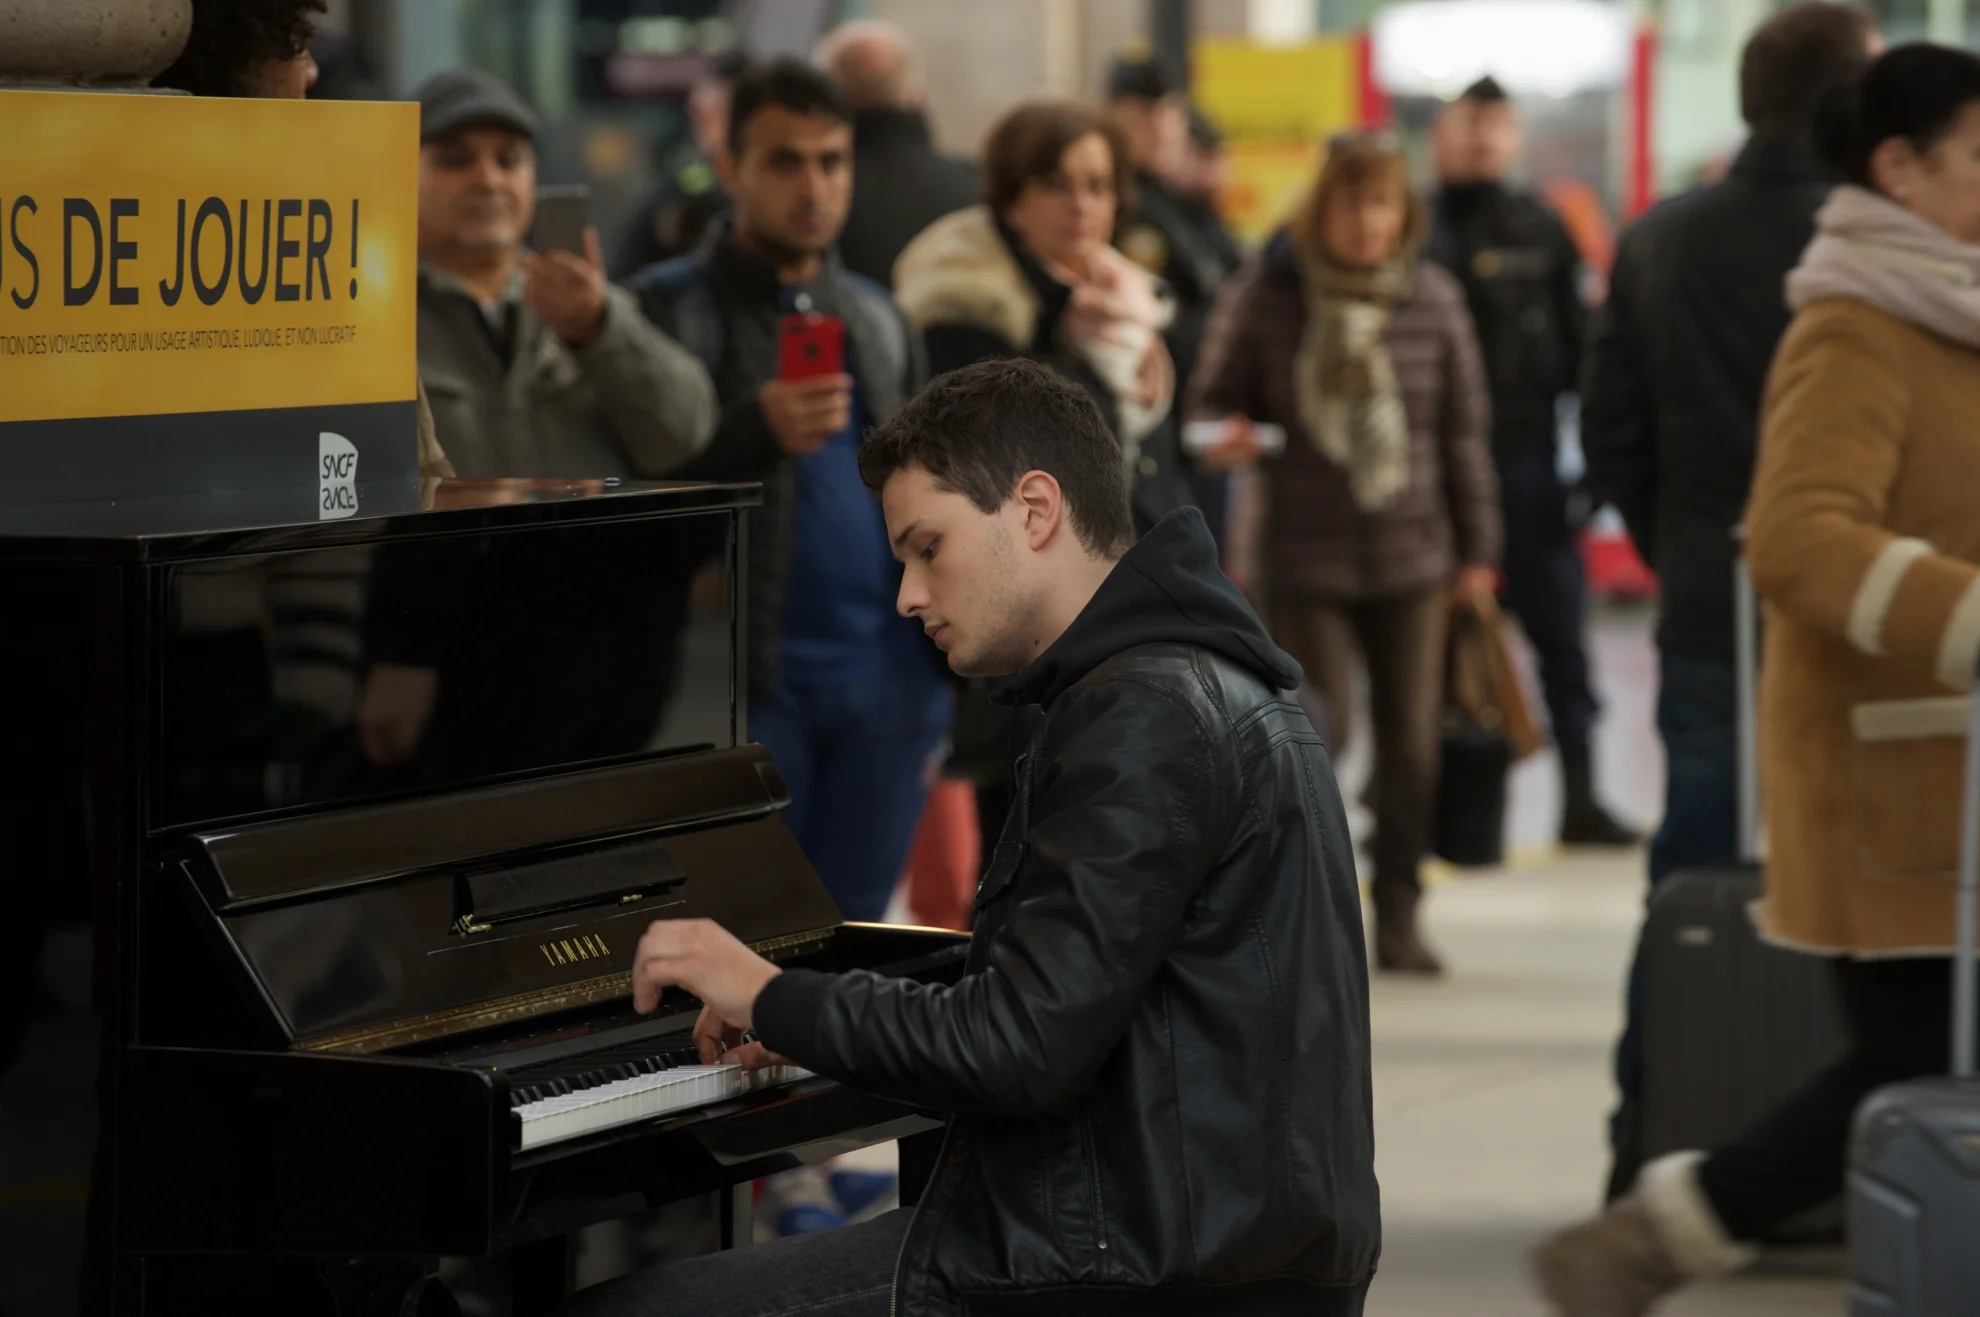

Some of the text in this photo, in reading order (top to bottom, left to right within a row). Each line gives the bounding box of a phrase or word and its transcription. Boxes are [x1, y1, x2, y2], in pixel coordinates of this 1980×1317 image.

[0, 194, 39, 310] S
[63, 197, 139, 306] DE
[159, 196, 332, 307] JOUER
[28, 335, 46, 355] DES
[49, 333, 108, 354] VOYAGEURS
[111, 332, 136, 352] POUR
[139, 331, 153, 351] UN
[155, 331, 187, 351] USAGE
[189, 329, 241, 350] ARTISTIQUE,
[244, 328, 283, 348] LUDIQUE,
[286, 327, 296, 346] ET
[298, 326, 317, 345] NON
[322, 453, 355, 479] SNCF
[539, 933, 611, 966] YAMAHA
